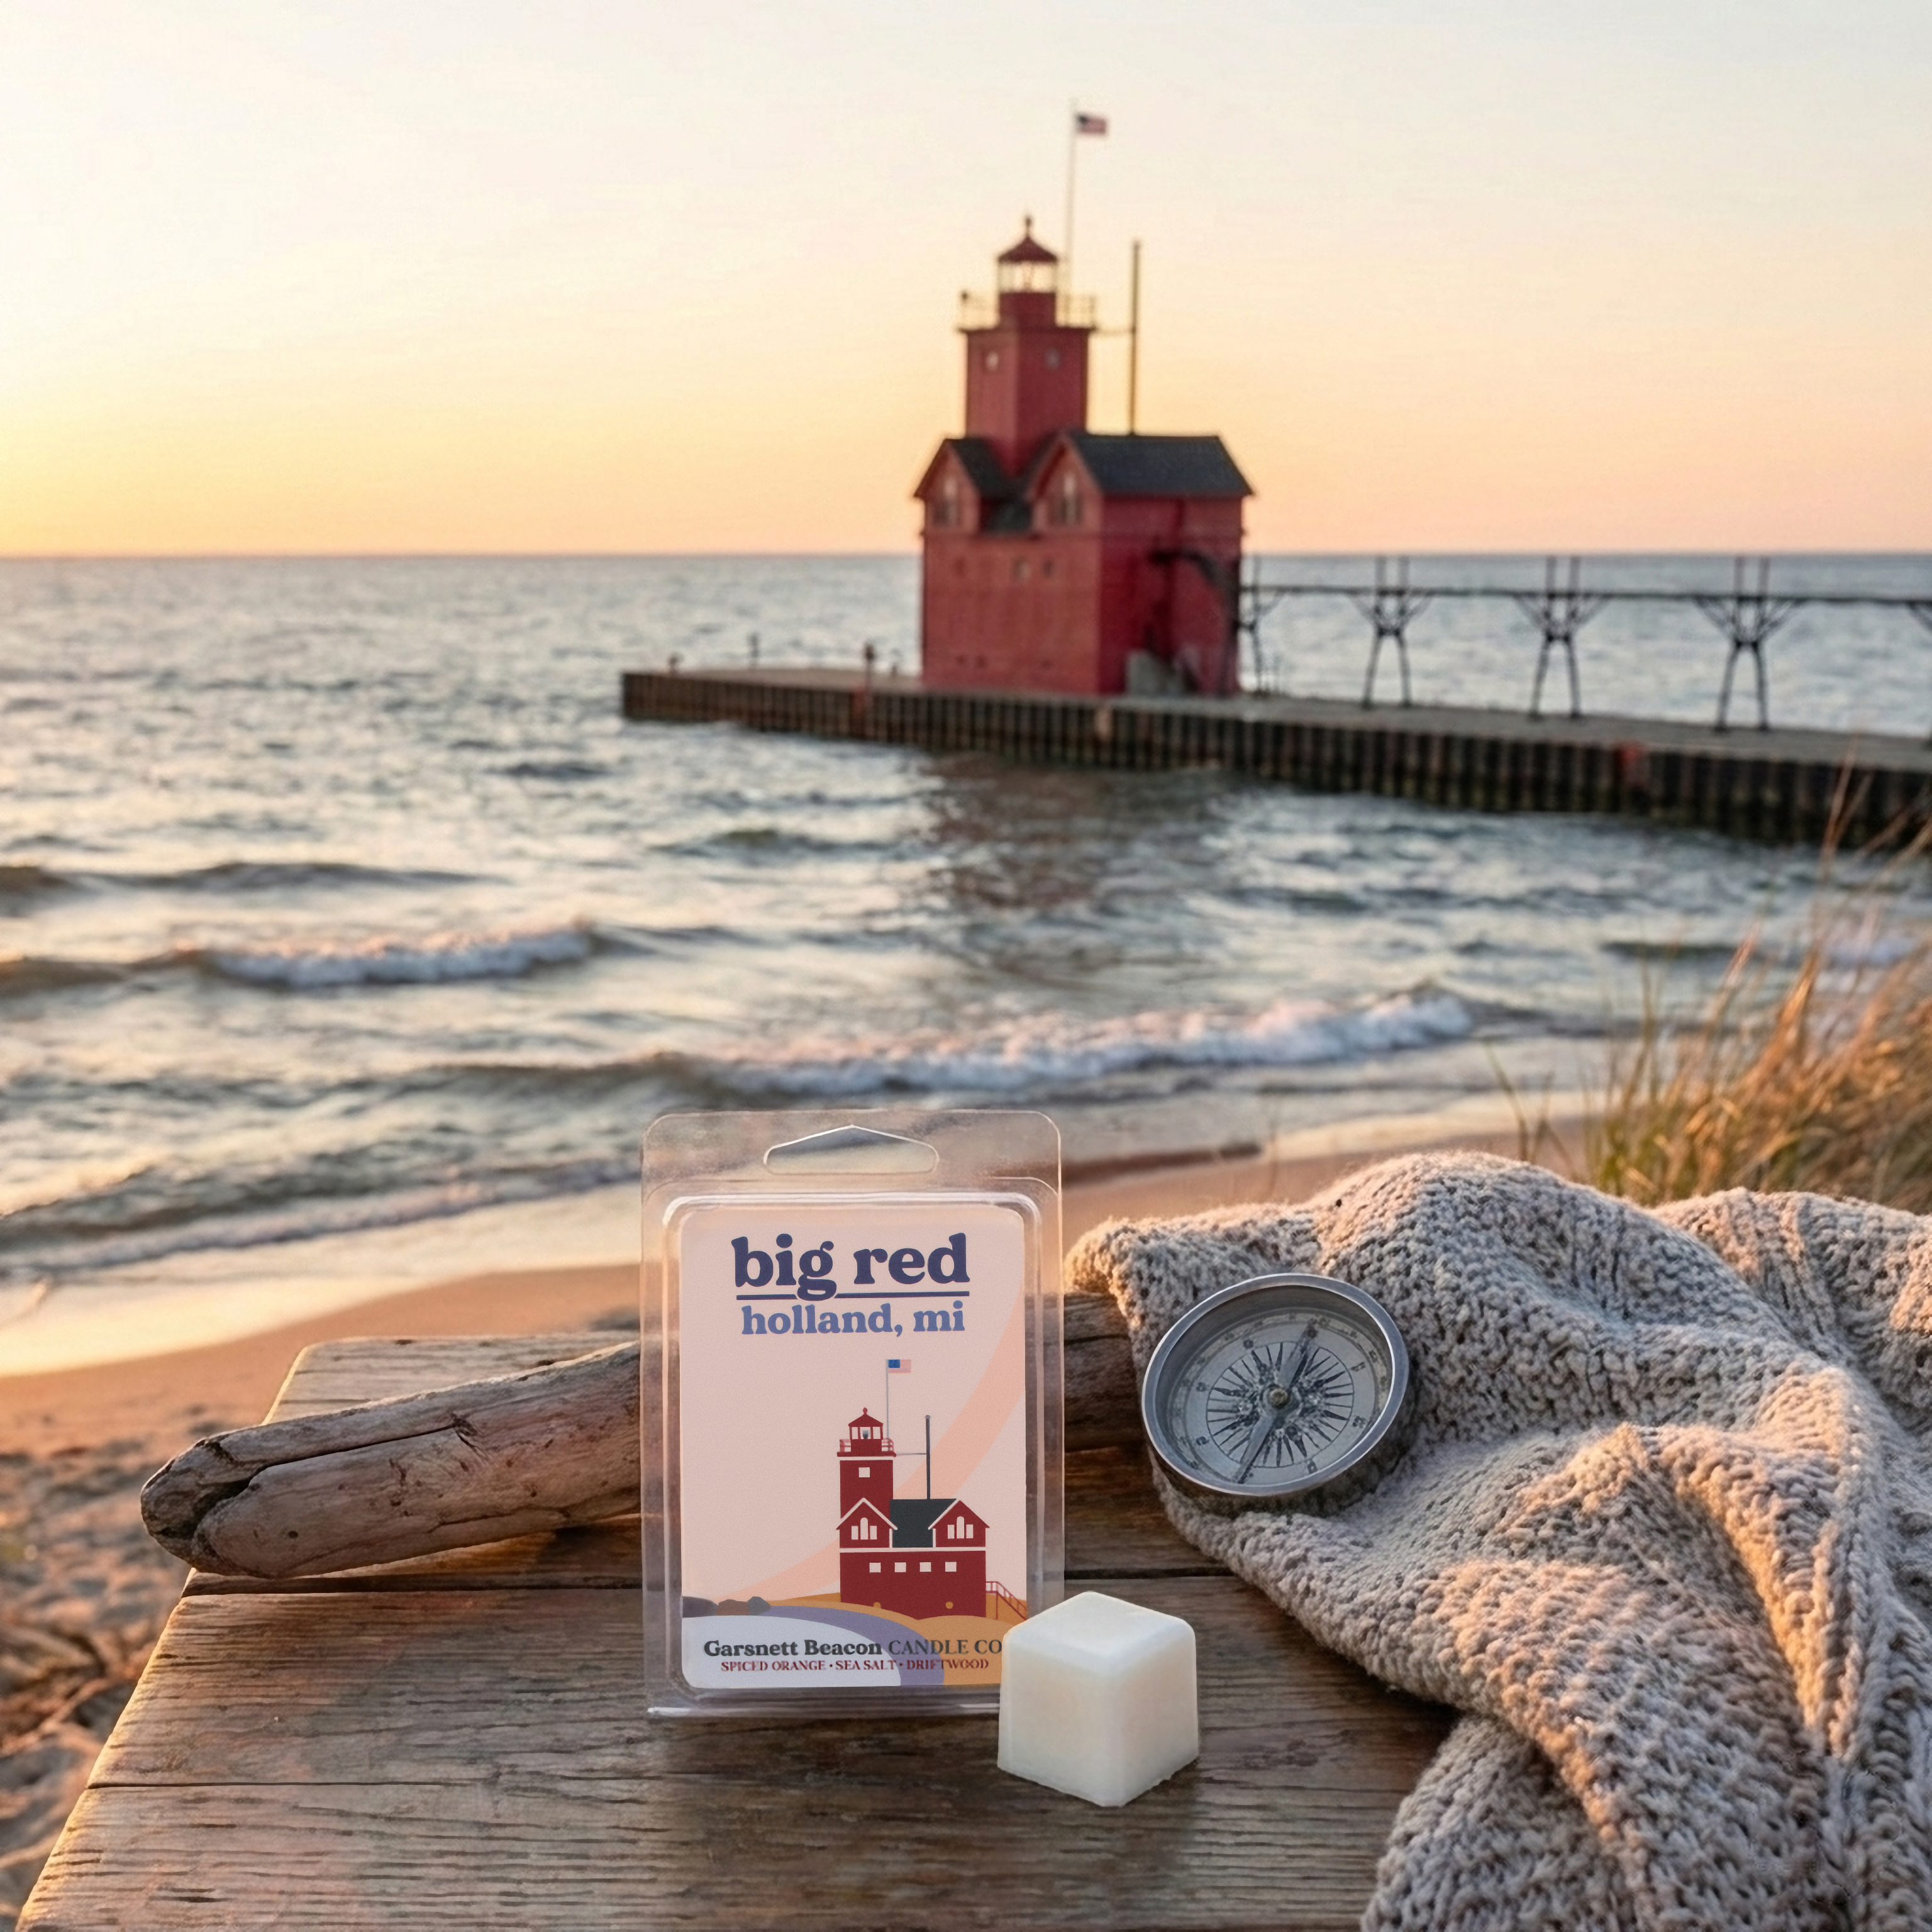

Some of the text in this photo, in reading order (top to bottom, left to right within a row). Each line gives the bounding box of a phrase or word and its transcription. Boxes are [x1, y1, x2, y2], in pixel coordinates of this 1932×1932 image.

[731, 1233, 970, 1301] big red
[741, 1300, 965, 1337] holland, mi
[704, 1640, 799, 1657] Garsnett
[805, 1639, 882, 1655] Beacon
[888, 1639, 969, 1655] CANDLE
[721, 1659, 989, 1672] SPICED ORANGE SEA SALT DRIFTWOOD
